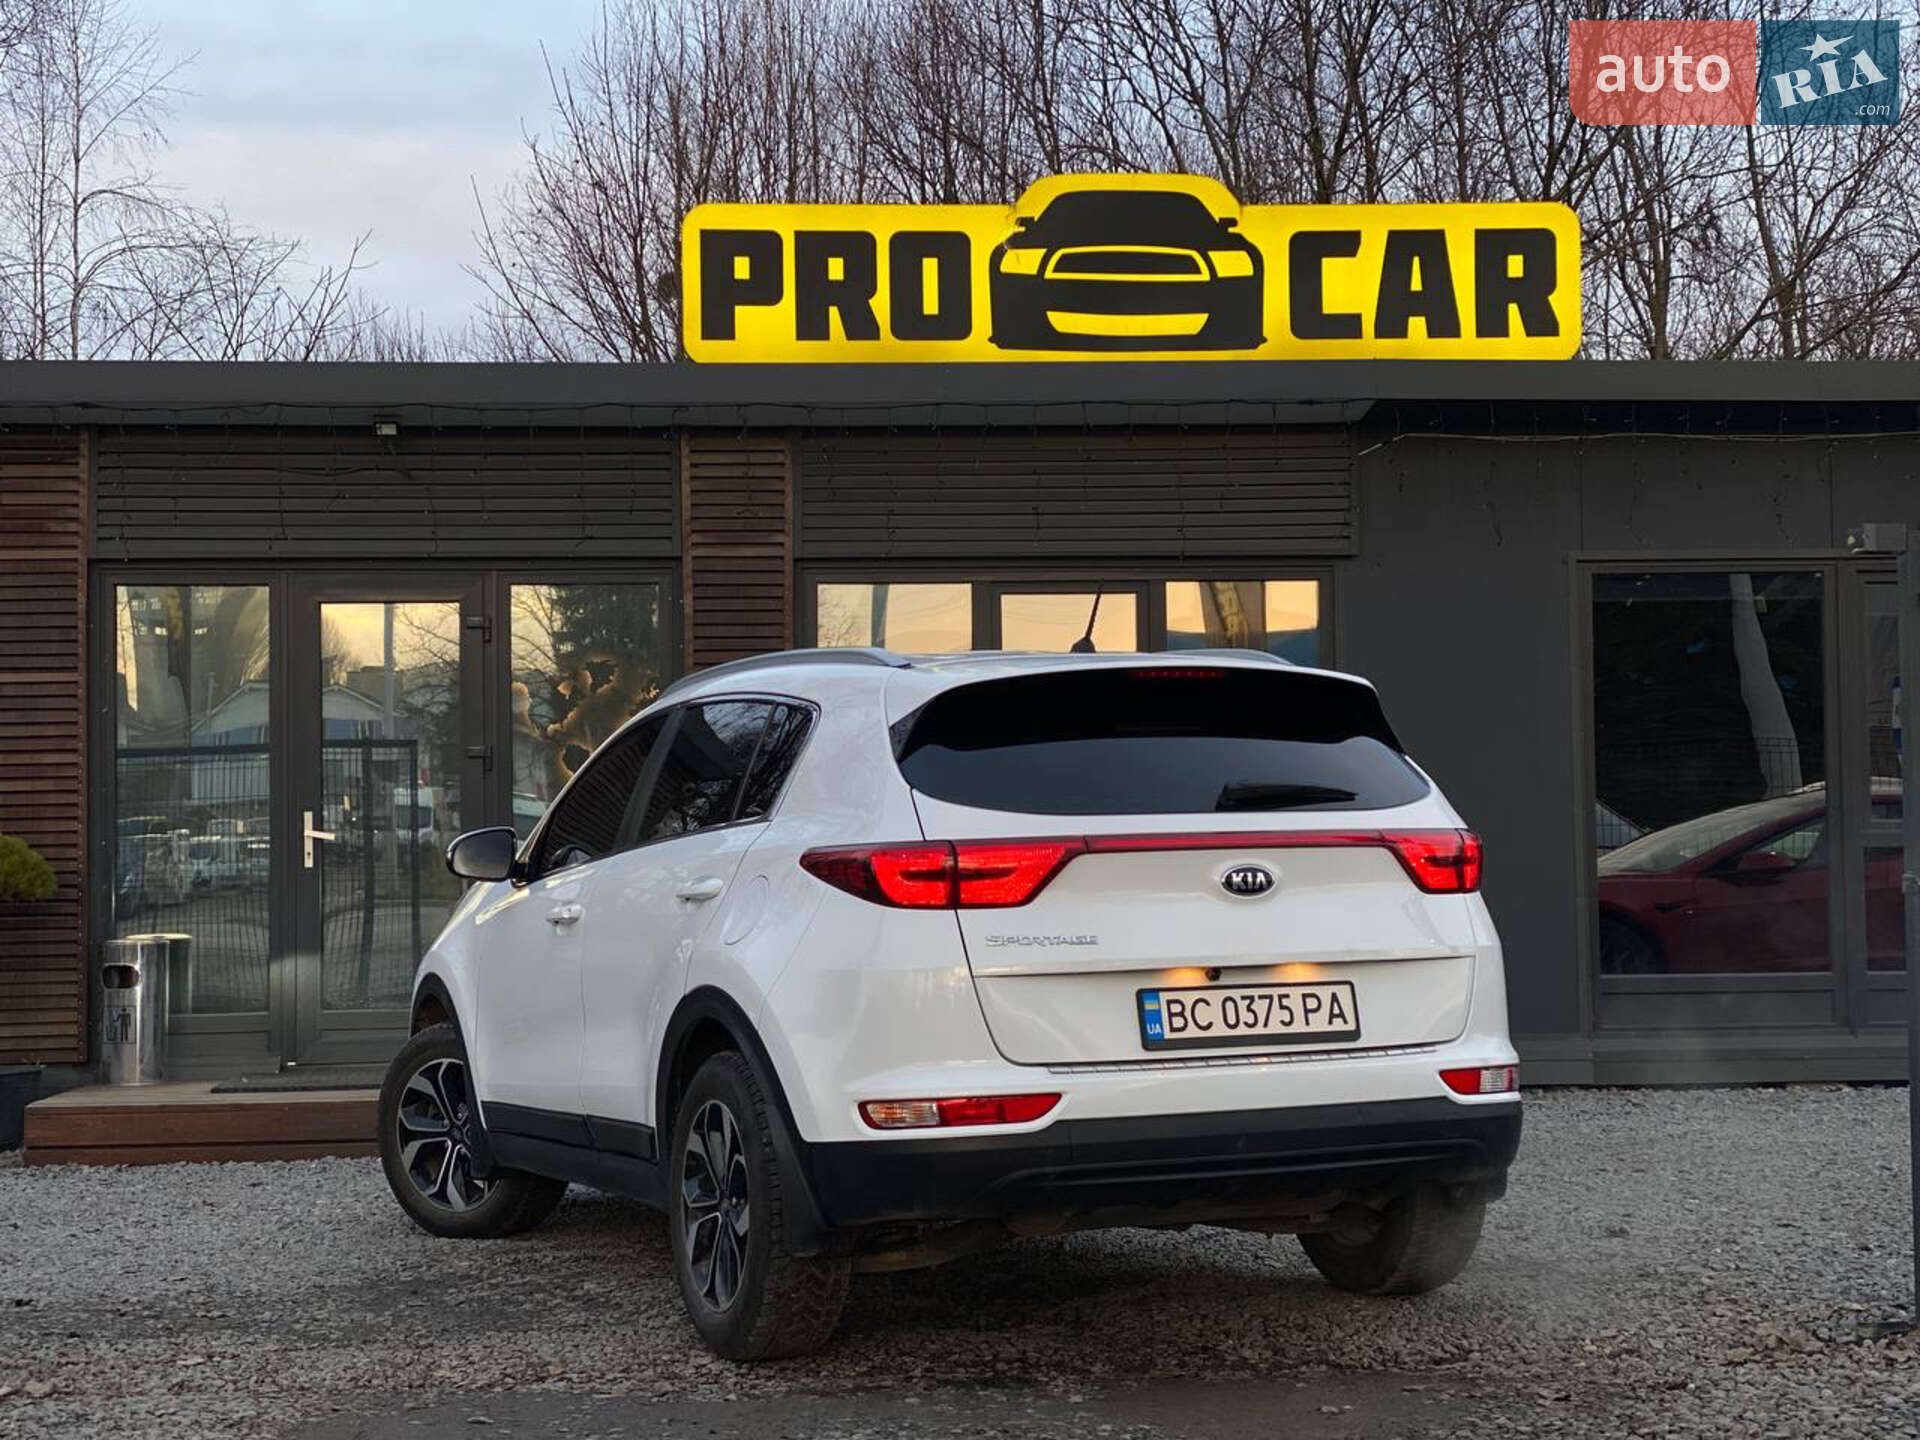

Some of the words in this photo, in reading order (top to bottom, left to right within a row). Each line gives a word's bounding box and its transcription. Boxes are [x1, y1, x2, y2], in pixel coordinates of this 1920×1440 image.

[699, 229, 972, 341] PRO
[1289, 228, 1560, 340] CAR
[1231, 872, 1267, 890] KIA
[985, 935, 1099, 947] SPORTAGE
[1166, 997, 1213, 1034] BC
[1221, 991, 1295, 1030] 0375
[1302, 991, 1349, 1026] PA
[1146, 1023, 1162, 1034] UA
